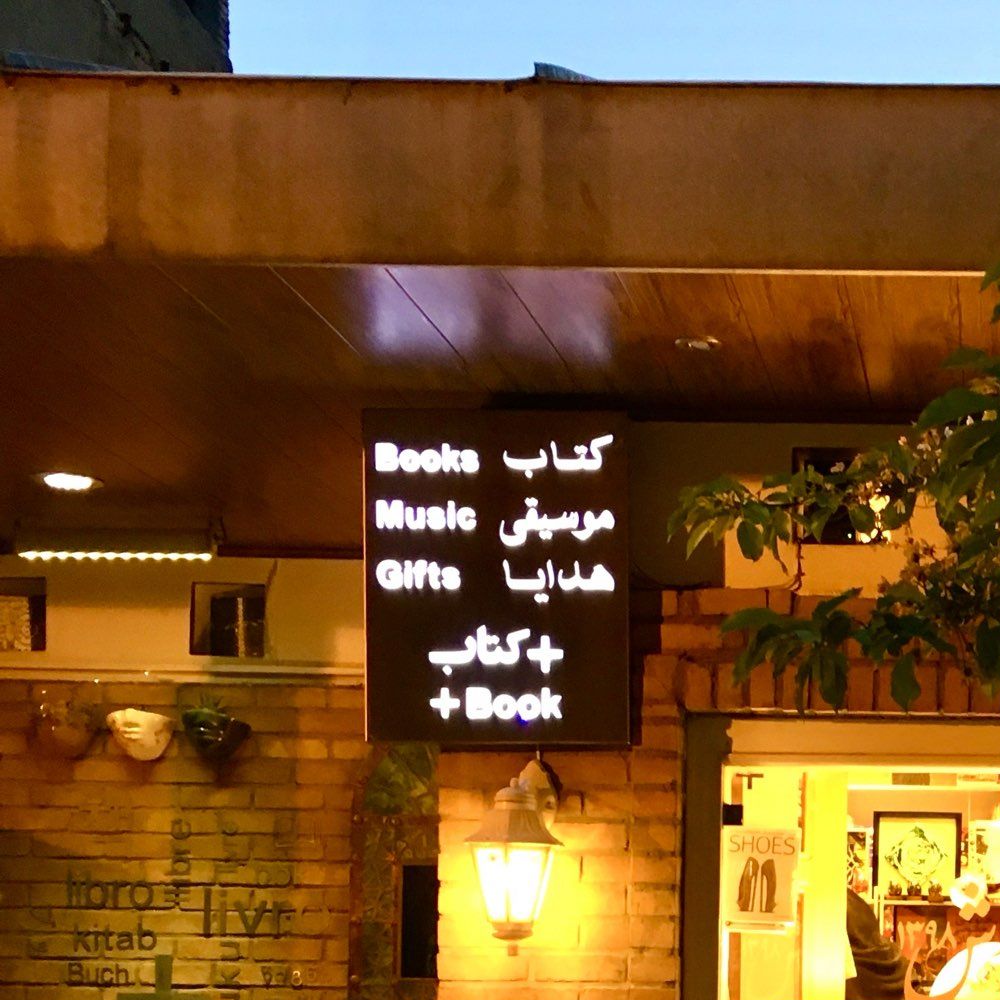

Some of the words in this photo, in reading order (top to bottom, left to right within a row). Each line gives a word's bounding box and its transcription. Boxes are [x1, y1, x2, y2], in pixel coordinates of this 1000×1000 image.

[375, 442, 480, 472] Books
[503, 434, 613, 478] کتاب
[375, 500, 477, 530] Music
[375, 559, 462, 590] Gifts
[503, 559, 615, 603] هدایا
[729, 835, 796, 856] SHOES
[73, 914, 157, 952] kitab
[68, 961, 130, 985] Buch
